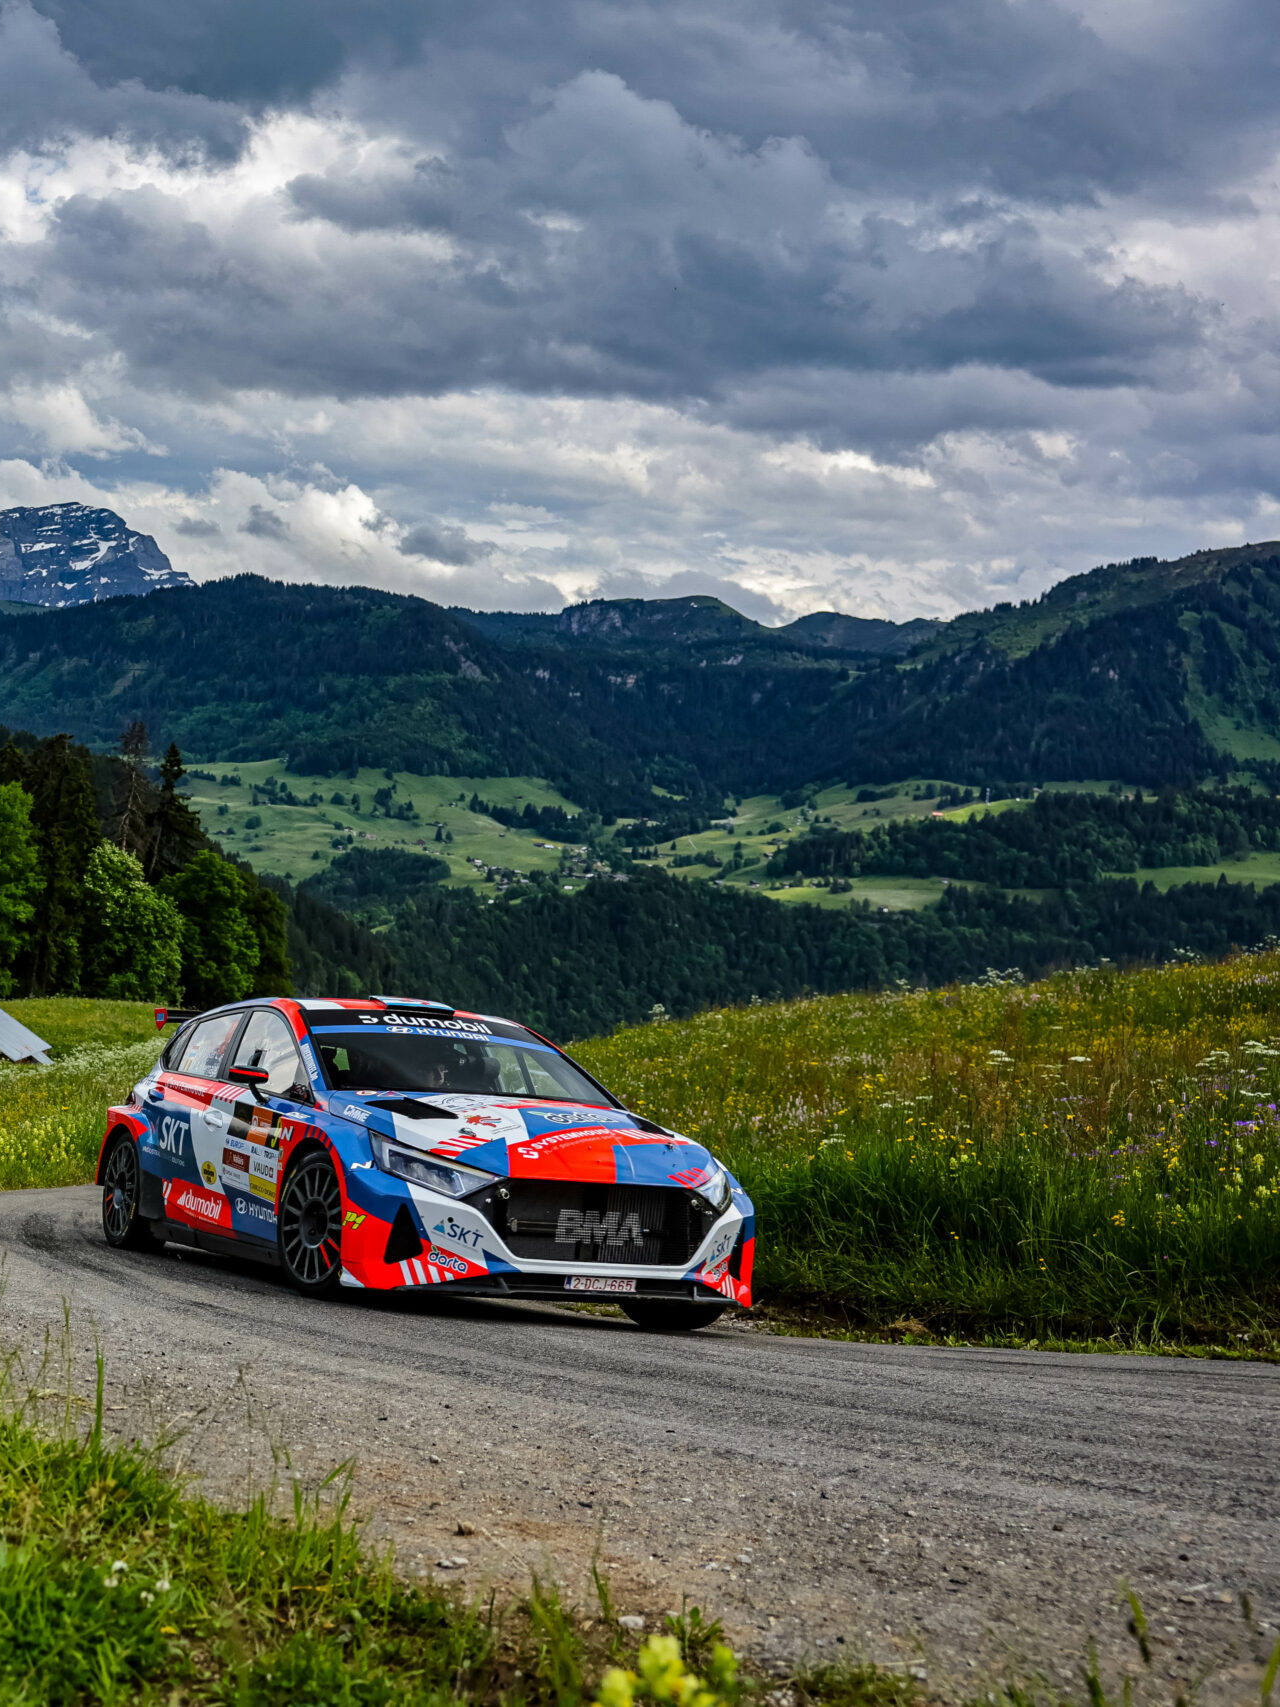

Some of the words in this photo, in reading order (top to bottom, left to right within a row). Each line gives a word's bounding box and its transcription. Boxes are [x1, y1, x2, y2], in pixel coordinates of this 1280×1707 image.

[383, 1013, 493, 1034] dumobil
[417, 1027, 490, 1042] HYUNDAI
[160, 1115, 189, 1156] SKT
[254, 1160, 269, 1177] VAUD
[185, 1189, 223, 1220] dumobil
[248, 1202, 278, 1224] HYUNDA
[447, 1223, 484, 1248] SKT
[554, 1208, 644, 1247] BMA
[428, 1250, 468, 1274] darta
[573, 1277, 634, 1292] 2-DCJ-665
